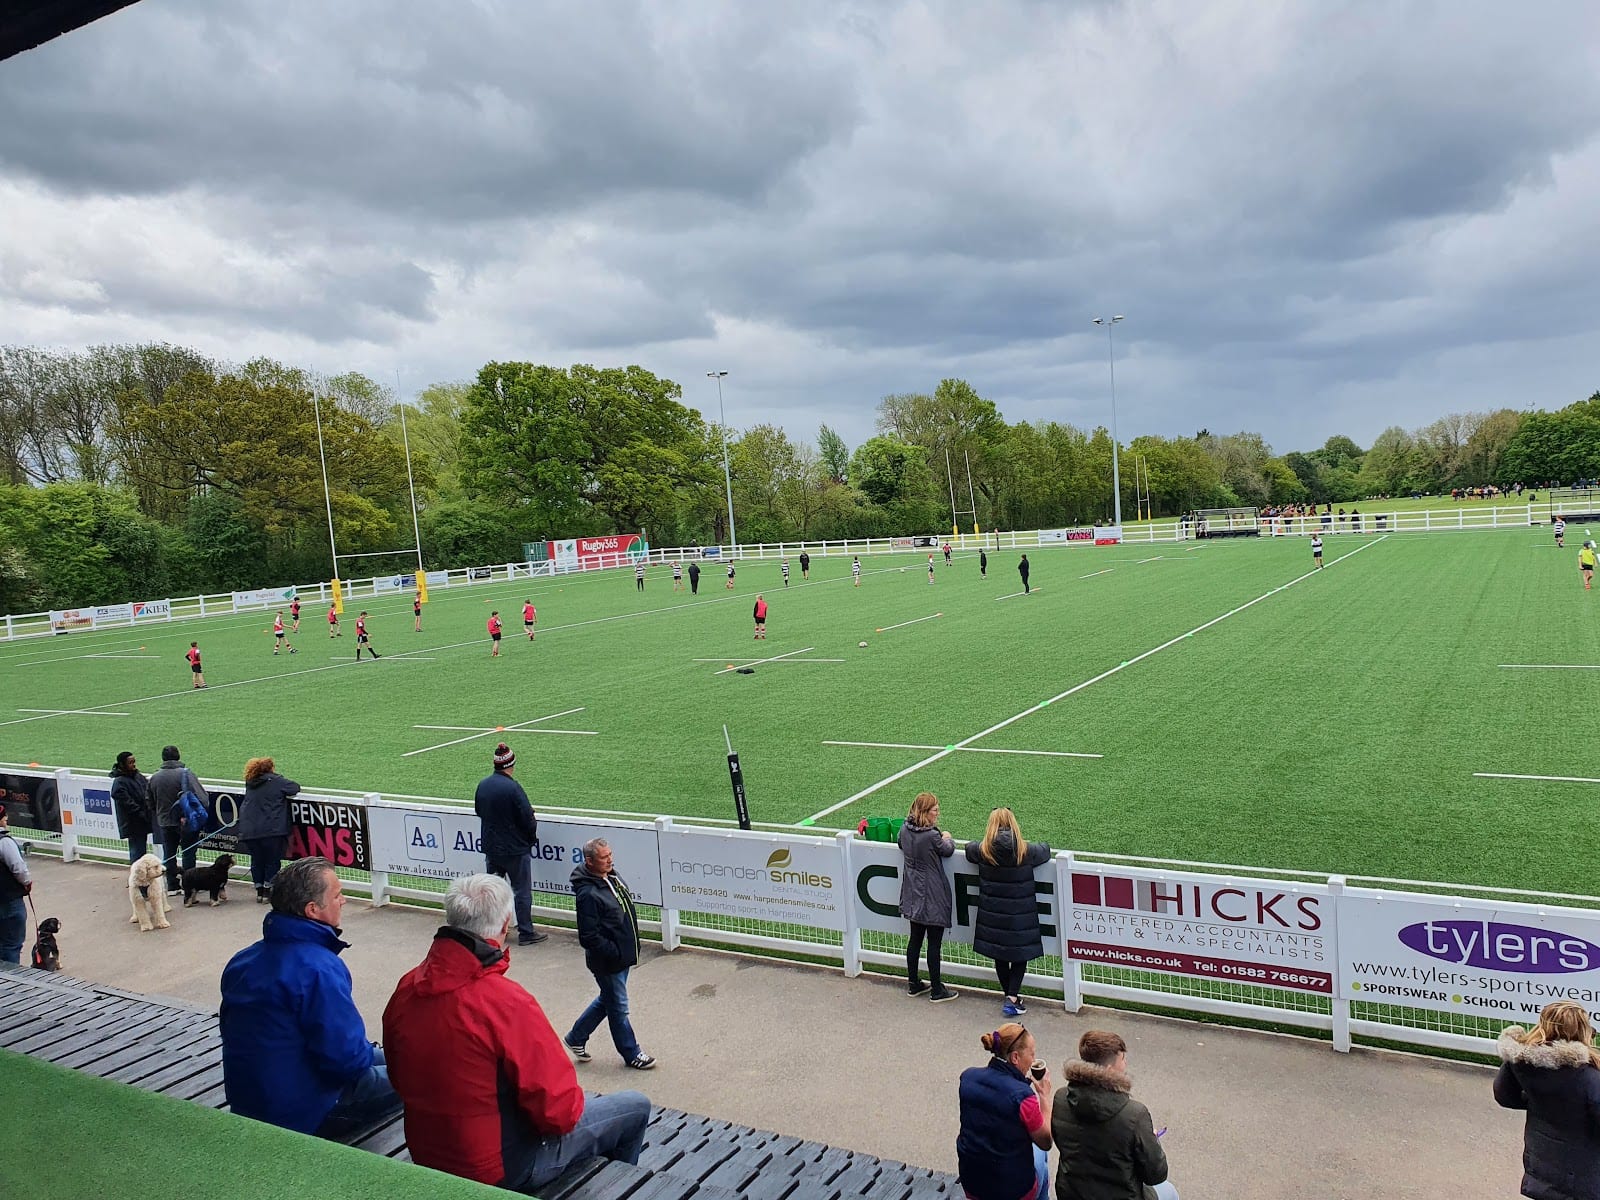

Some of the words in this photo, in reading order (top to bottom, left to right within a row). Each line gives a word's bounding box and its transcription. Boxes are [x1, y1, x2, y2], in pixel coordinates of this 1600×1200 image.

[582, 538, 618, 552] Rugby365
[145, 604, 169, 615] KIER
[62, 793, 111, 808] Workspace
[75, 815, 114, 829] Interiors
[291, 803, 362, 830] PENDEN
[285, 825, 355, 866] ANS
[411, 826, 438, 848] Aa
[670, 858, 767, 881] harpenden
[770, 870, 833, 889] smiles
[671, 885, 697, 895] 01582
[698, 887, 728, 898] 763420
[773, 886, 802, 895] DENTAL
[804, 890, 833, 899] STUDIO
[696, 898, 737, 914] Supporting
[738, 905, 758, 917] sport
[759, 907, 767, 915] in
[768, 909, 811, 921] Harpenden
[1150, 881, 1322, 931] HICKS
[1073, 910, 1174, 931] CHARTERED
[1184, 924, 1323, 949] ACCOUNTANTS
[1073, 922, 1124, 936] AUDIT
[1133, 928, 1145, 939] &
[1196, 936, 1324, 961] SPECIALISTS
[1423, 920, 1589, 970] tylers
[1072, 946, 1182, 968] www.hicks.co.uk
[1193, 961, 1218, 973] Tel:
[1221, 965, 1266, 980] 01582
[1270, 970, 1327, 987] 766677
[1363, 982, 1447, 1002] SPORTSWEAR
[1463, 996, 1515, 1011] SCHOOL
[1520, 1002, 1541, 1014] WE
